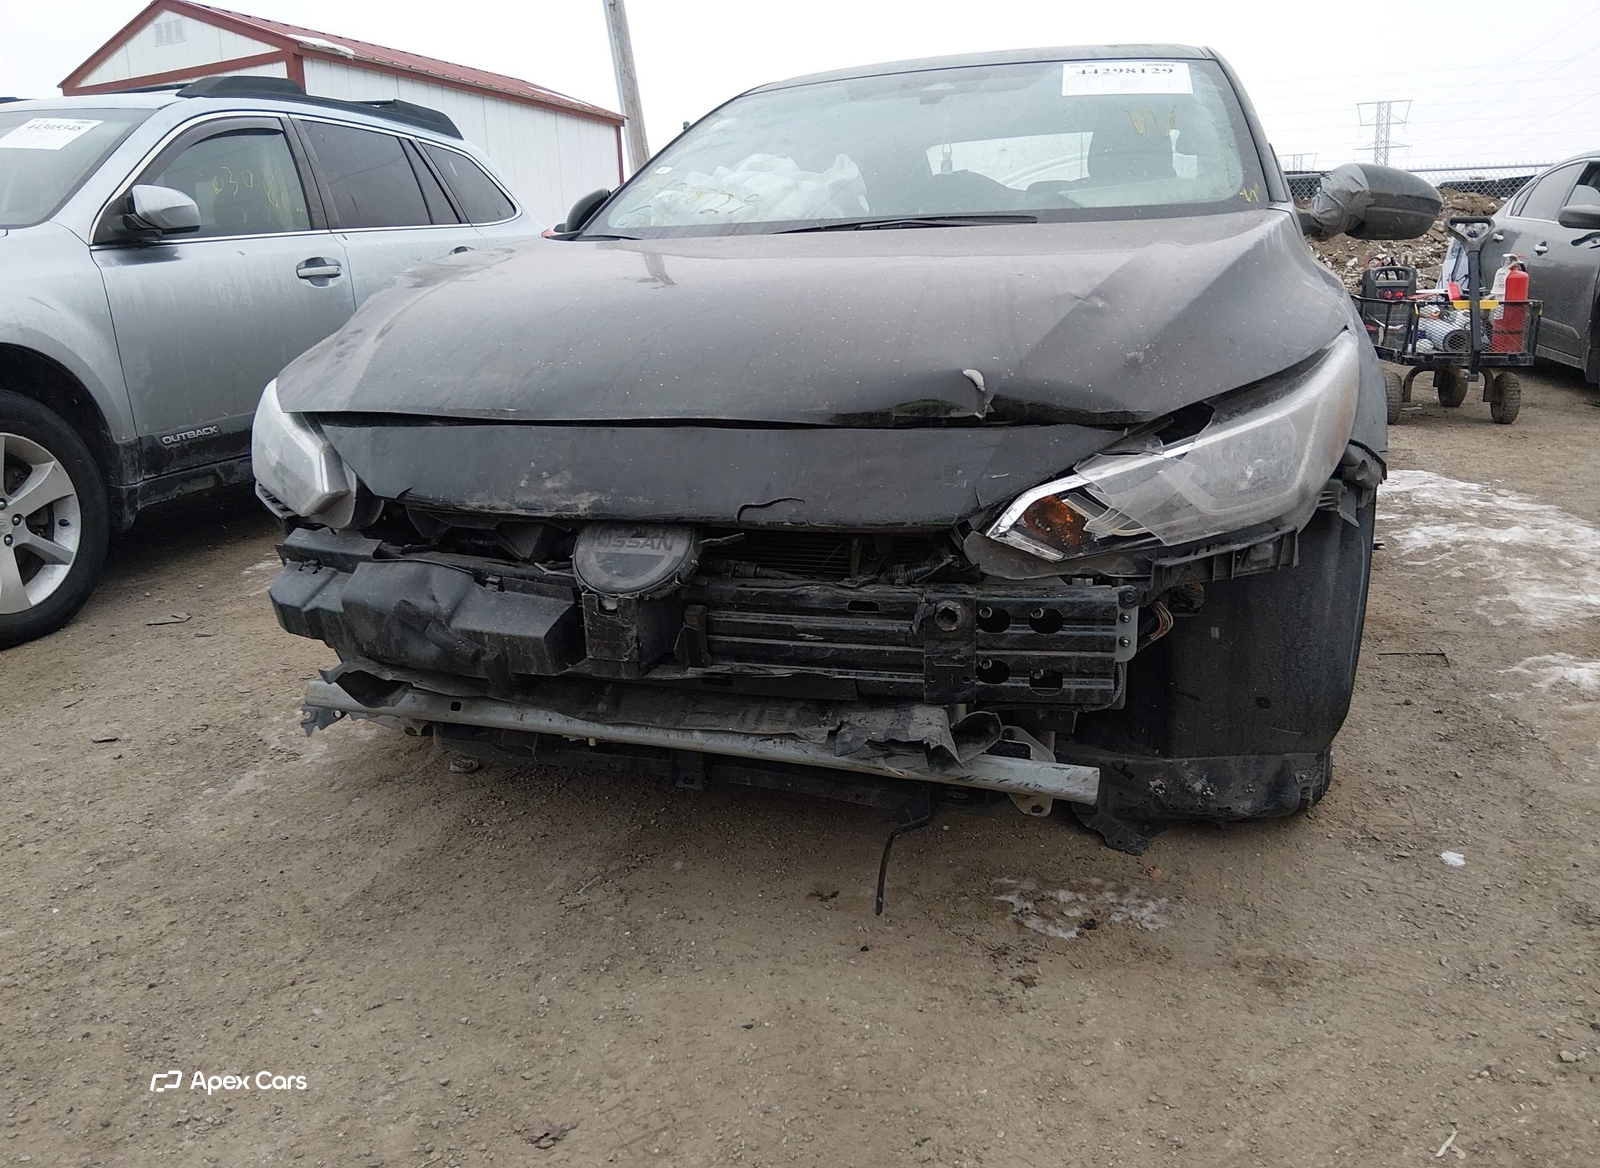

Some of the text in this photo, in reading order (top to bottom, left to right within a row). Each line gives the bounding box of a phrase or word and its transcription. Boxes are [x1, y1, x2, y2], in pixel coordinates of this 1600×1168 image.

[1076, 67, 1174, 75] 44298129
[162, 425, 219, 444] OUTBACK
[589, 533, 674, 552] NISSAN
